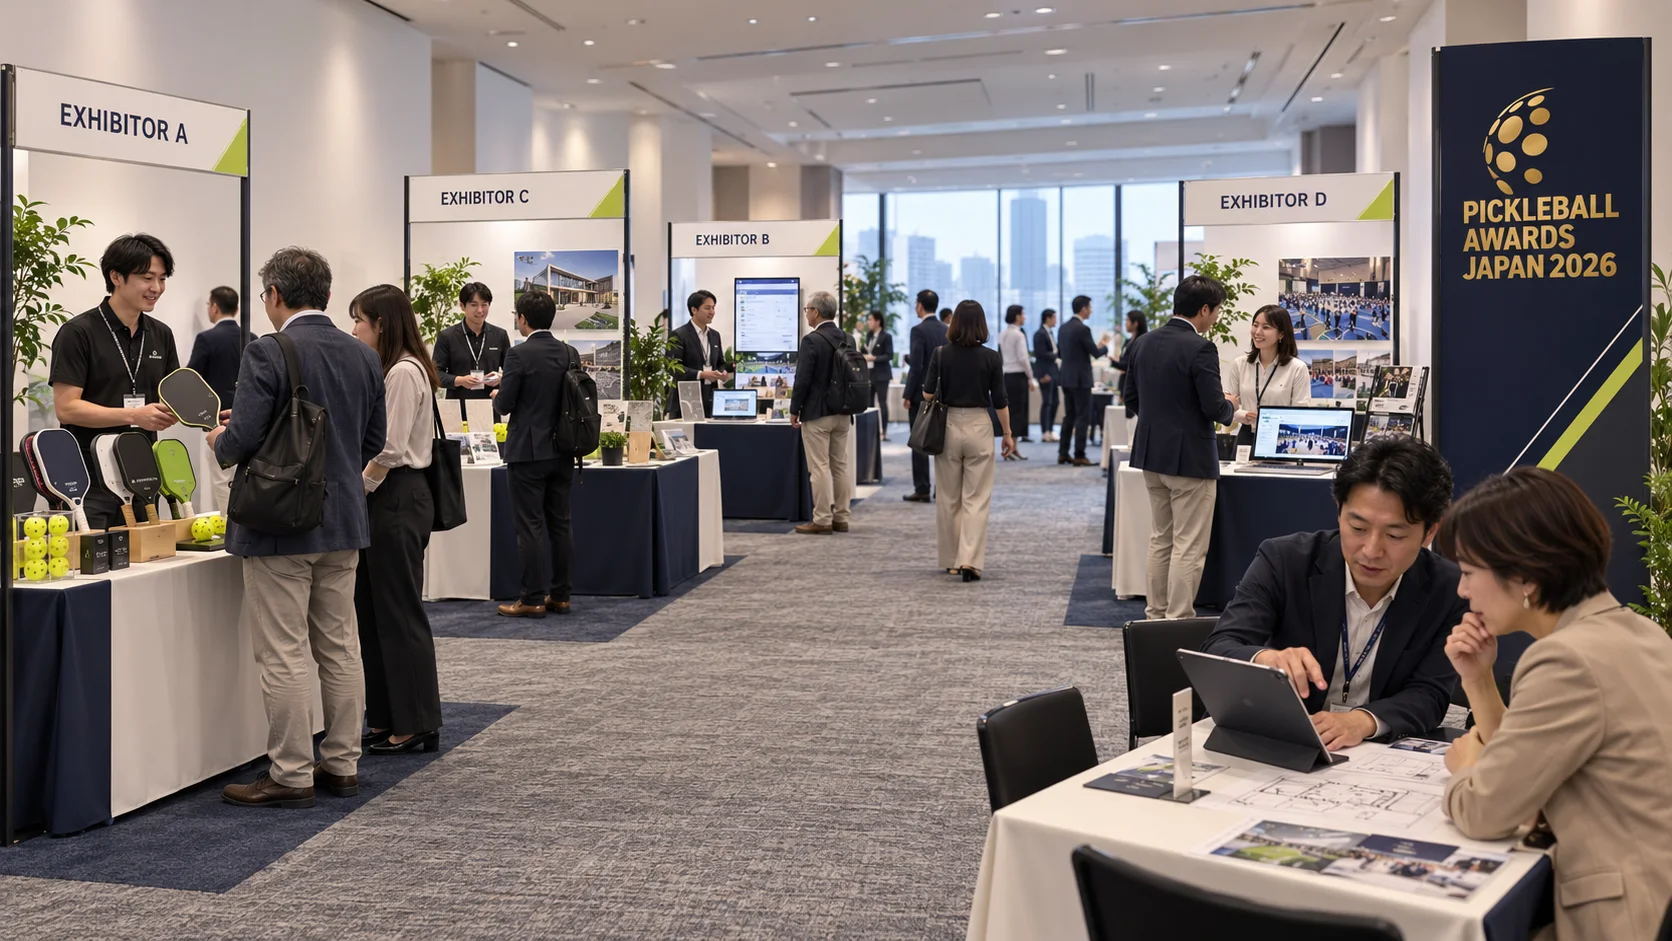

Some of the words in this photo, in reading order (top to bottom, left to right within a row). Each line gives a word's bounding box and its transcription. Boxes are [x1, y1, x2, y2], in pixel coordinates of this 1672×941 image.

[61, 102, 169, 142] EXHIBITOR
[175, 123, 188, 144] A
[441, 190, 515, 206] EXHIBITOR
[518, 189, 530, 204] C
[1220, 193, 1309, 210] EXHIBITOR
[1315, 192, 1327, 207] D
[1463, 193, 1620, 224] PICKLEBALL
[695, 234, 757, 246] EXHIBITOR
[761, 233, 770, 245] B
[1463, 224, 1576, 252] AWARDS
[1463, 254, 1545, 281] JAPAN
[1549, 251, 1618, 279] 2026
